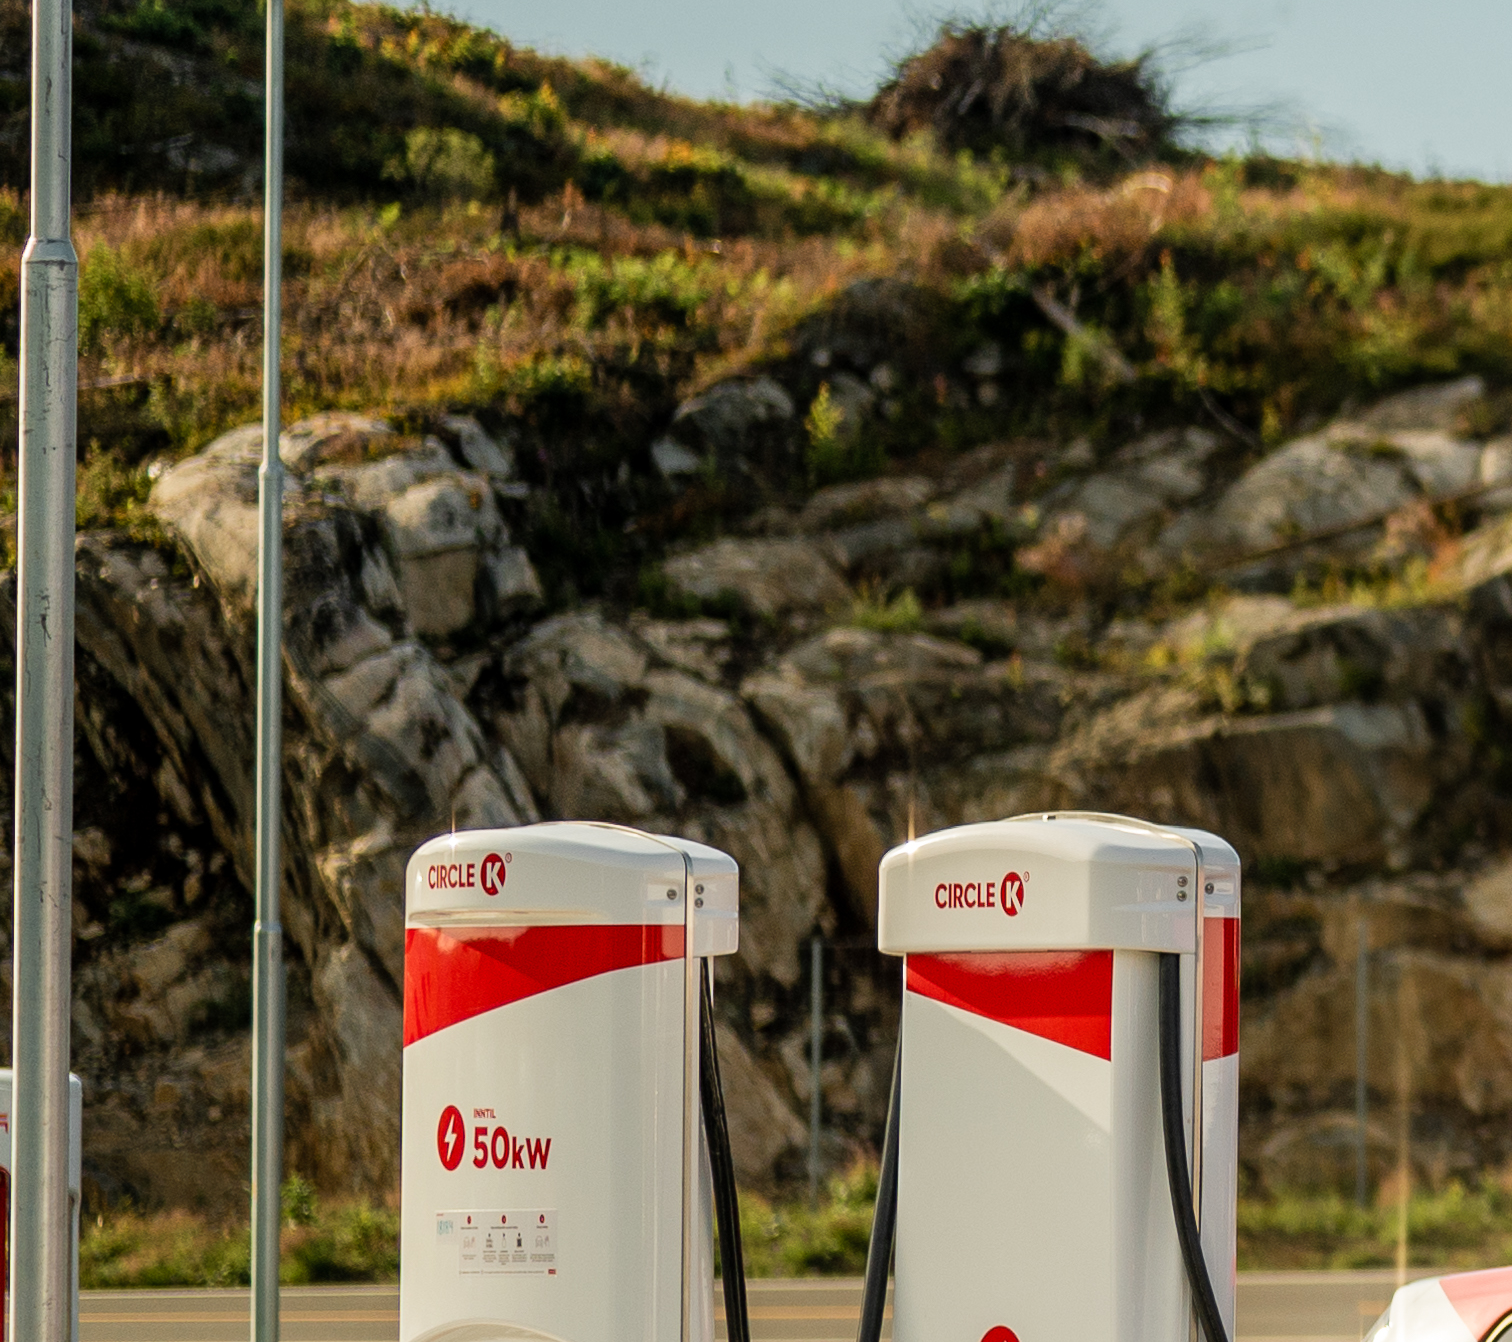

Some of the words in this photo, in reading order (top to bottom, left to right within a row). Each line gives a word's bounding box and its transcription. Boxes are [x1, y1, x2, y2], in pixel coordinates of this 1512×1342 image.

[428, 863, 476, 890] CIRCLE
[481, 854, 506, 895] K
[935, 882, 996, 909] CIRCLE
[1001, 872, 1024, 916] K
[472, 1126, 552, 1170] 50kW
